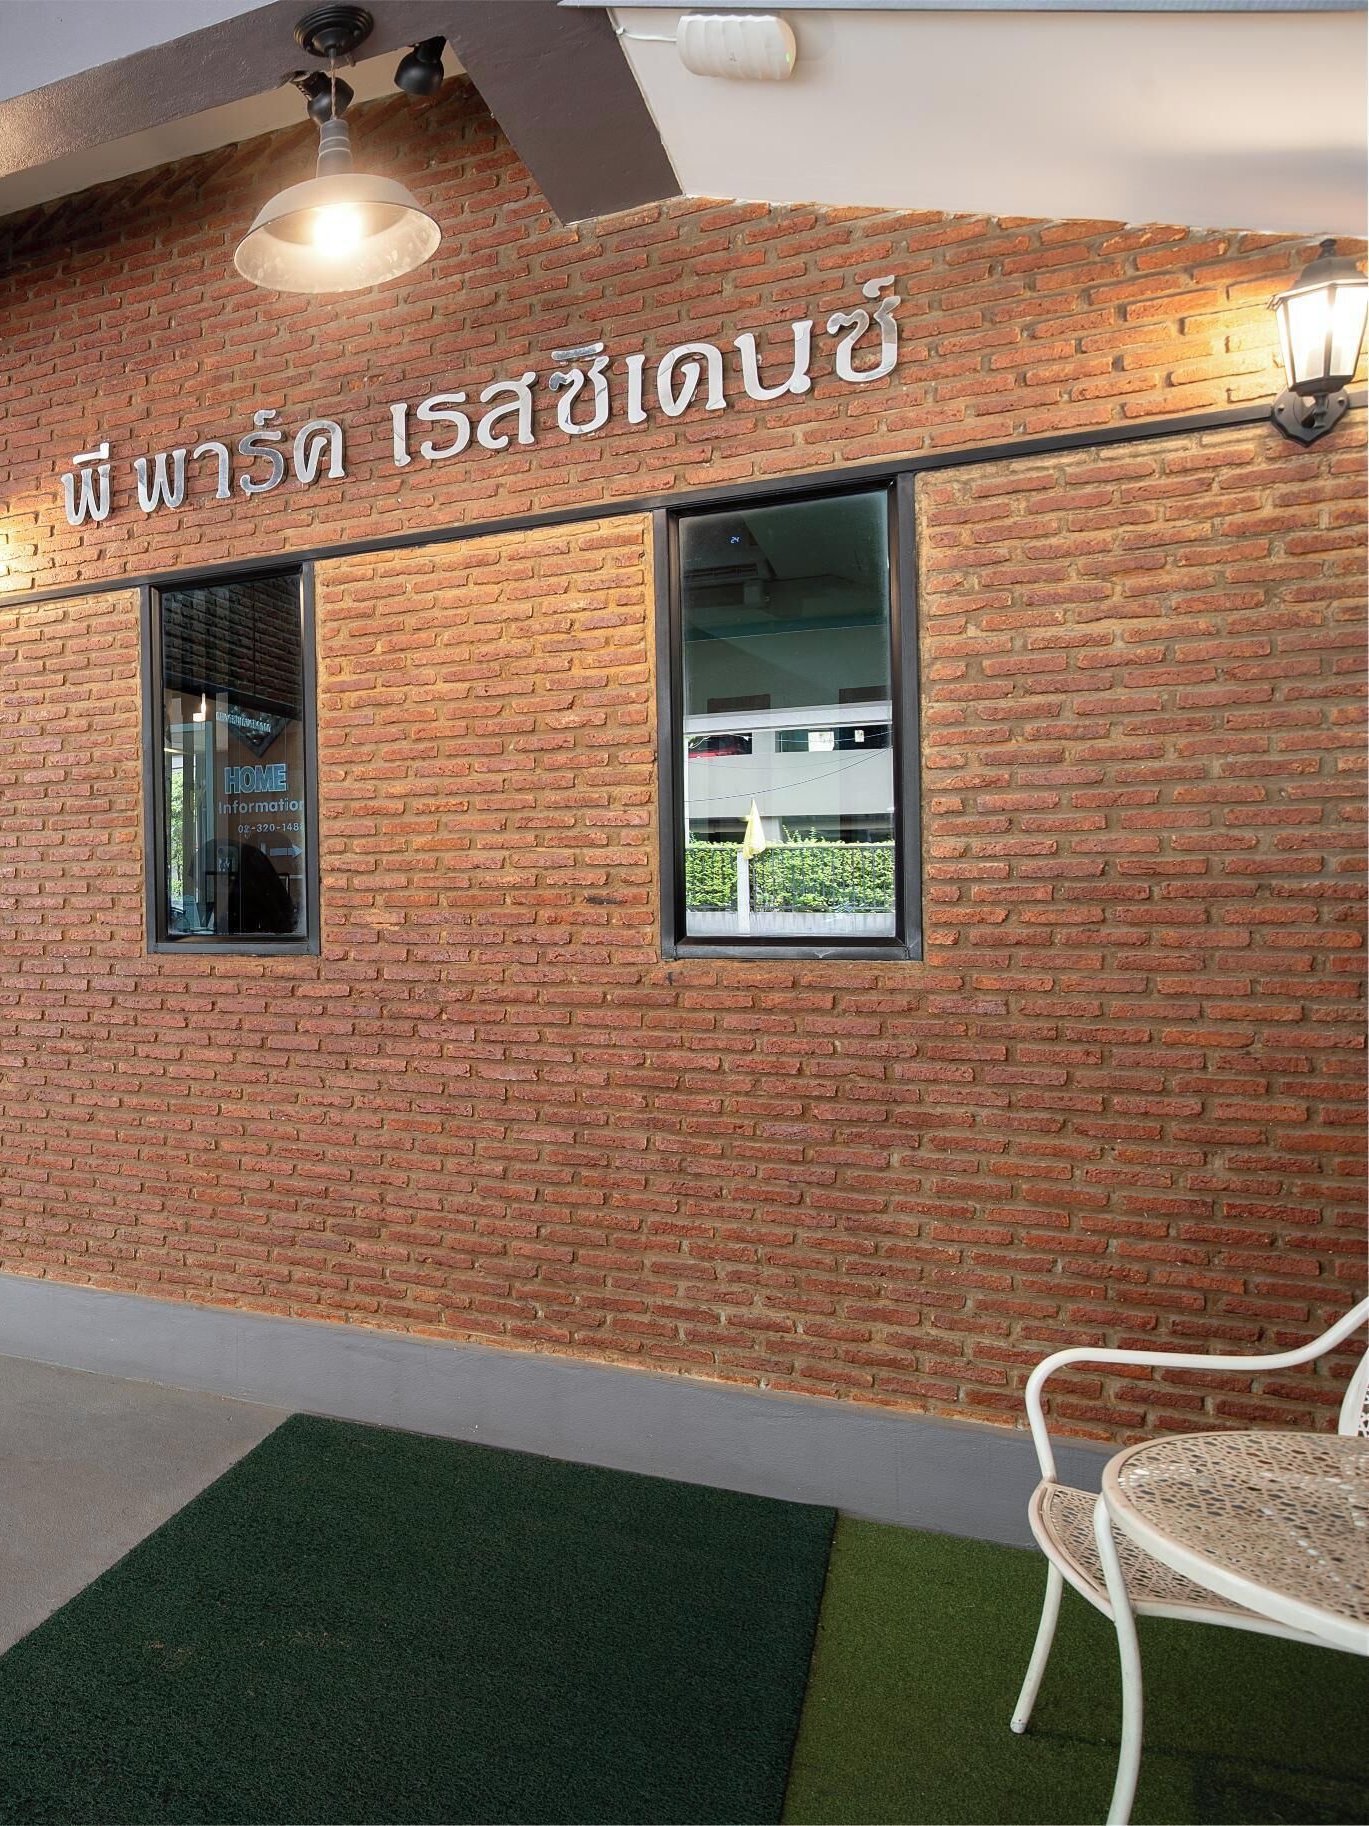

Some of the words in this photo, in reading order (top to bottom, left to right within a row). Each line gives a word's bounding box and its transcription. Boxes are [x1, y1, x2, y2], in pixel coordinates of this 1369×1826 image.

[61, 442, 111, 526] พี
[133, 409, 346, 513] พาร์ค
[390, 275, 902, 467] เรสซิเดนซ์
[224, 763, 287, 795] HOME
